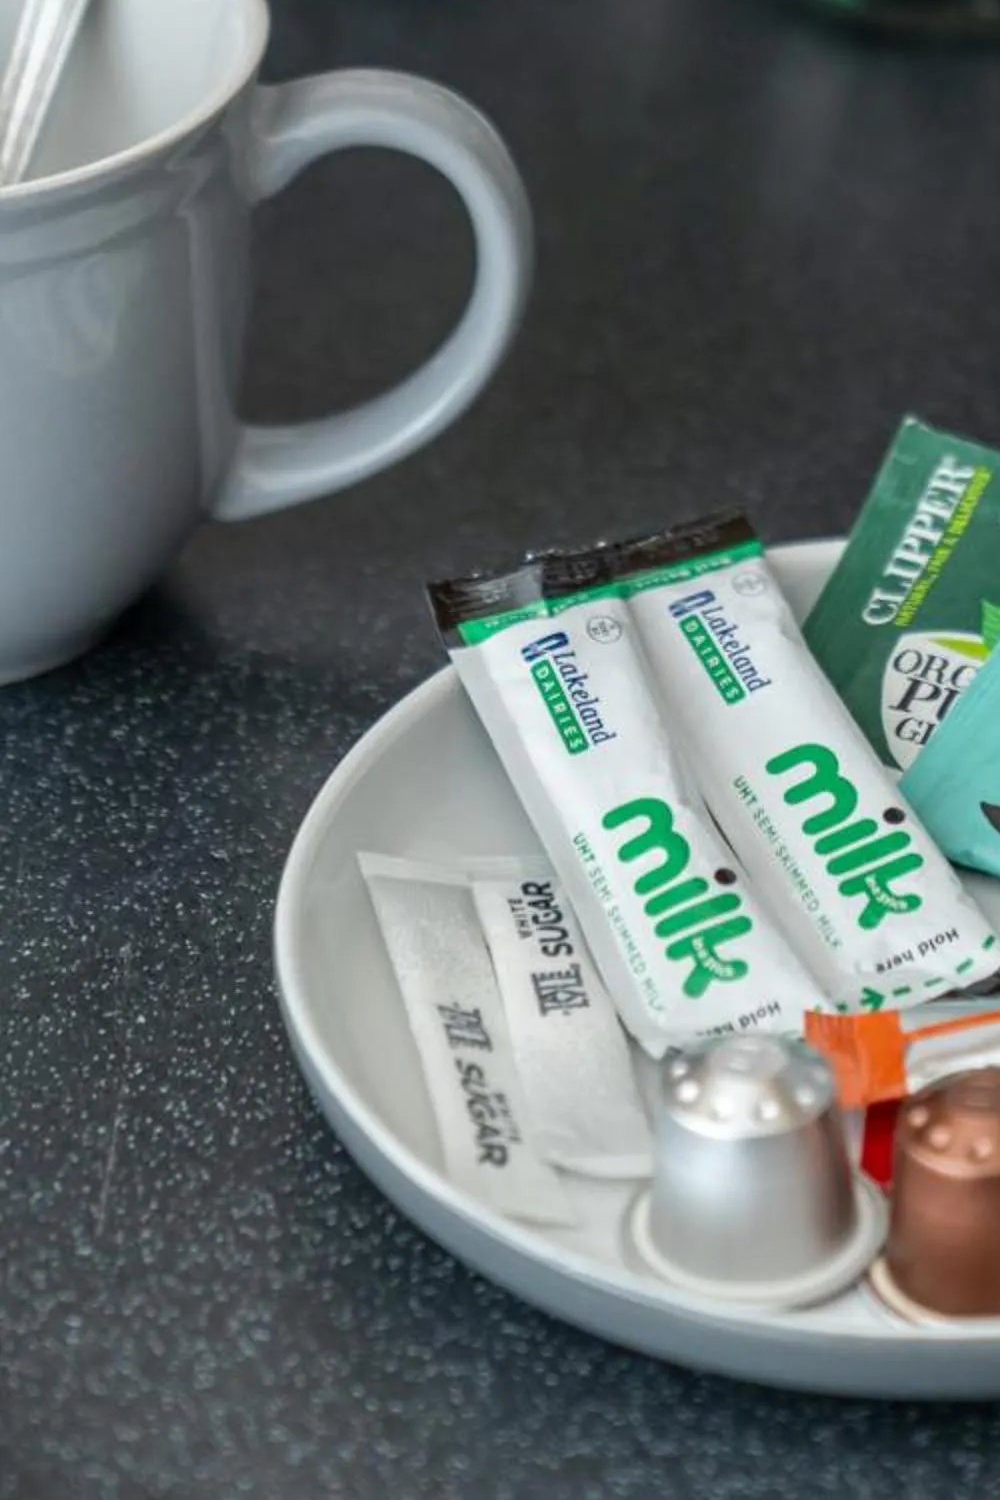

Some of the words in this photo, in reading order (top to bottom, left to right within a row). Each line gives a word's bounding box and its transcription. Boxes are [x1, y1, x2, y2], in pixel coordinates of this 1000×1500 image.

[861, 457, 975, 625] CLIPPER
[684, 618, 742, 703] DAIRIES
[702, 606, 773, 695] Lakeland
[533, 665, 585, 751] DAIRIES
[553, 650, 617, 747] Lakeland
[572, 831, 596, 864] UHT
[733, 775, 757, 807] UHT
[818, 913, 843, 949] MILK
[765, 743, 924, 929] milk
[507, 896, 532, 940] WHITE
[521, 880, 574, 958] SUGAR
[601, 796, 753, 998] milk
[917, 927, 960, 952] Hold
[875, 949, 915, 974] here
[740, 1001, 782, 1027] Hold
[455, 1057, 509, 1170] SUGAR
